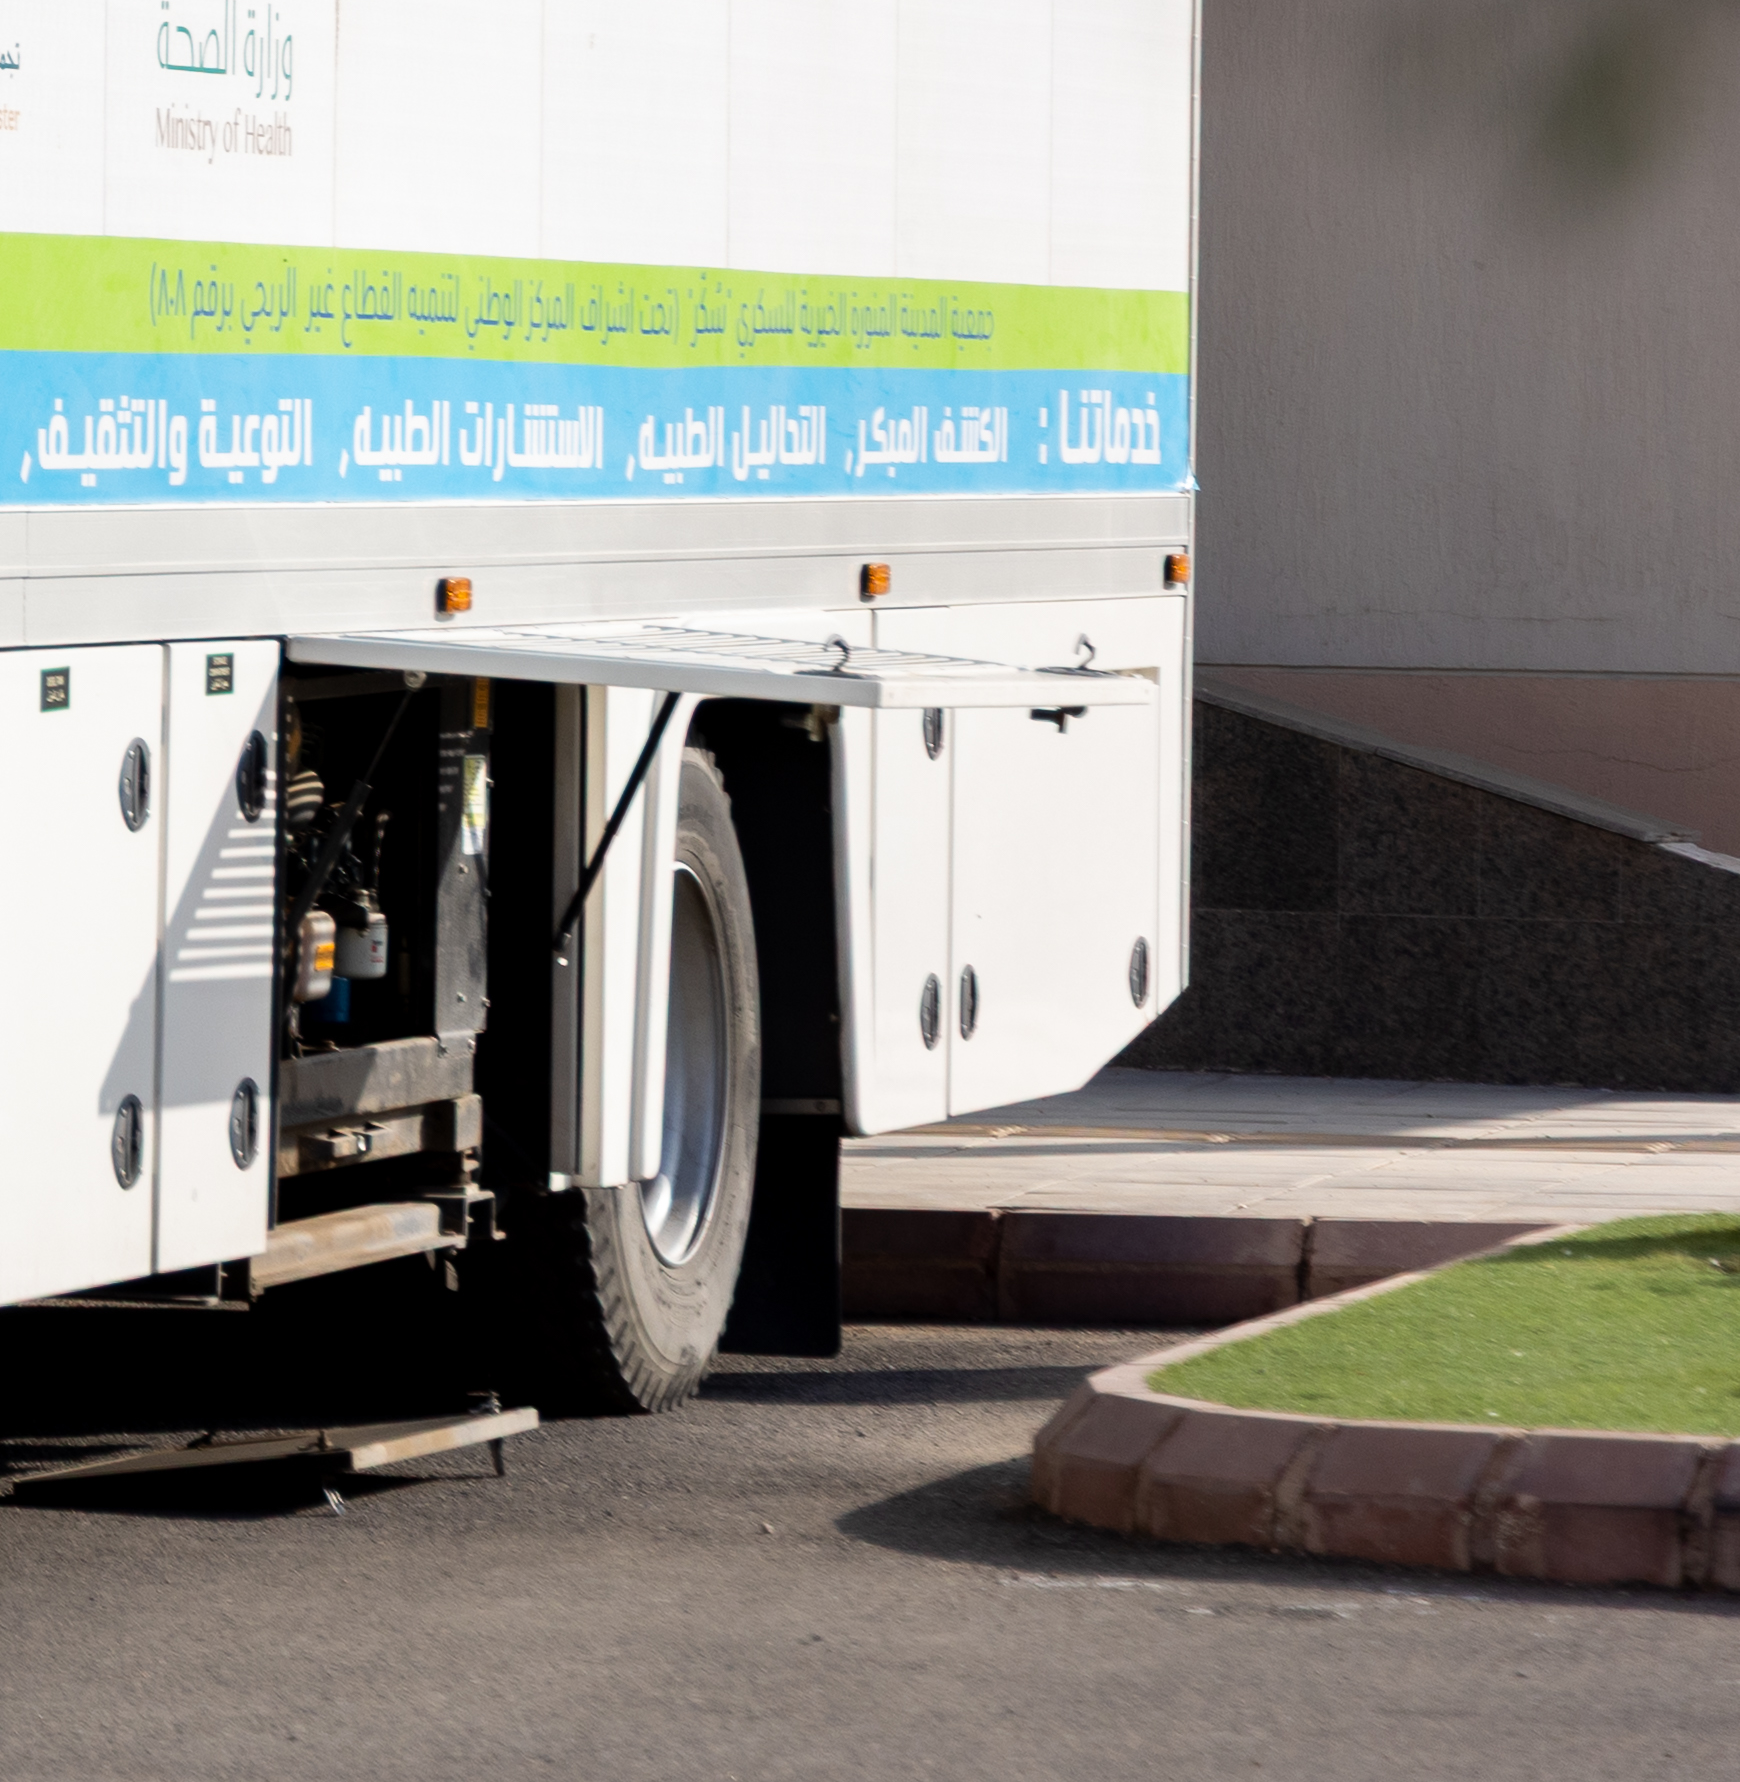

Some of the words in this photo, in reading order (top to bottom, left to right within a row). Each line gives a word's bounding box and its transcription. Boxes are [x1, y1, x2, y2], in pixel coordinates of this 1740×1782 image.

[157, 0, 236, 75] الصحة
[244, 3, 292, 101] وزارة
[155, 102, 218, 165] Ministry
[223, 107, 241, 153] of
[245, 111, 292, 157] Health
[190, 264, 234, 341] برقم
[241, 266, 296, 345] الربحي
[303, 268, 334, 333] غير
[341, 269, 402, 348] القطاع
[464, 275, 522, 351] الوطني
[524, 279, 574, 342] المركز
[800, 289, 847, 349] الخيرية
[851, 291, 897, 349] المنورة
[901, 293, 947, 350] المدينة
[951, 295, 995, 352] جمعية
[199, 398, 313, 485] التوعية
[459, 400, 603, 482] الاستشارات
[732, 404, 826, 482] التحاليل
[933, 406, 1008, 463] الكشف
[1060, 388, 1162, 465] خدماتنا
